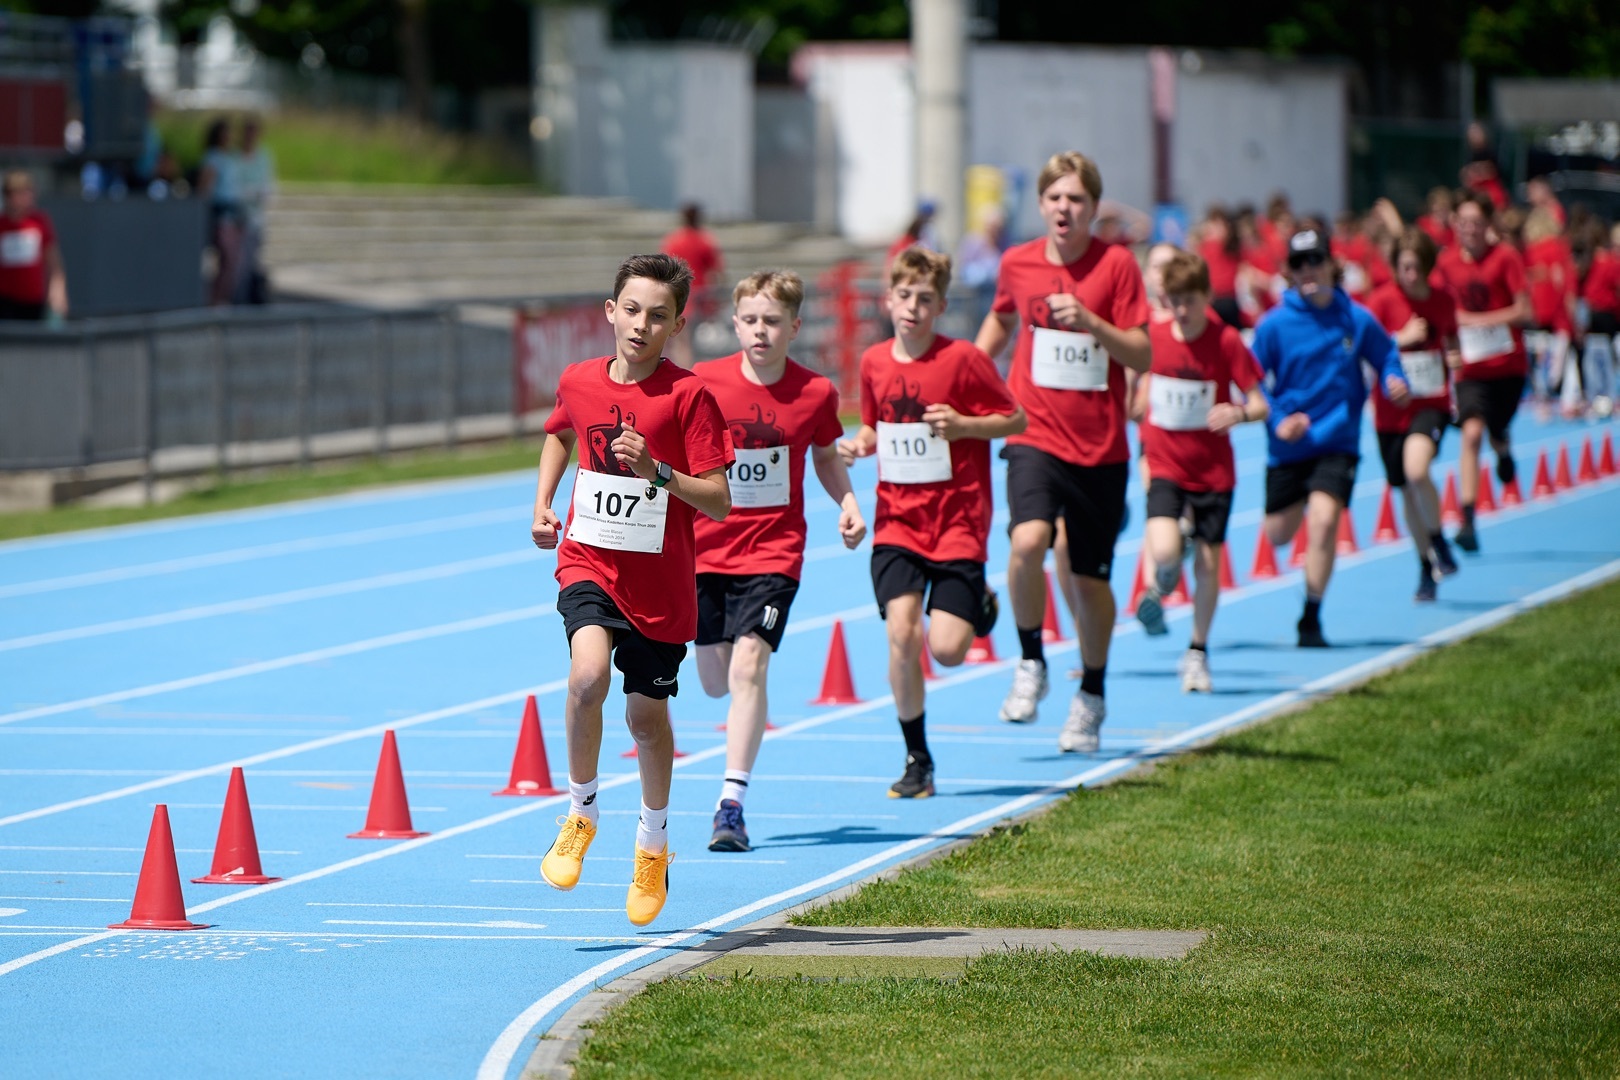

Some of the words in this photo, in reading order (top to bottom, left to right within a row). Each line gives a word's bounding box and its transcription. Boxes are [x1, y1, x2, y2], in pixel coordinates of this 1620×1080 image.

[1054, 346, 1088, 364] 104
[892, 438, 926, 456] 110
[594, 490, 640, 518] 107
